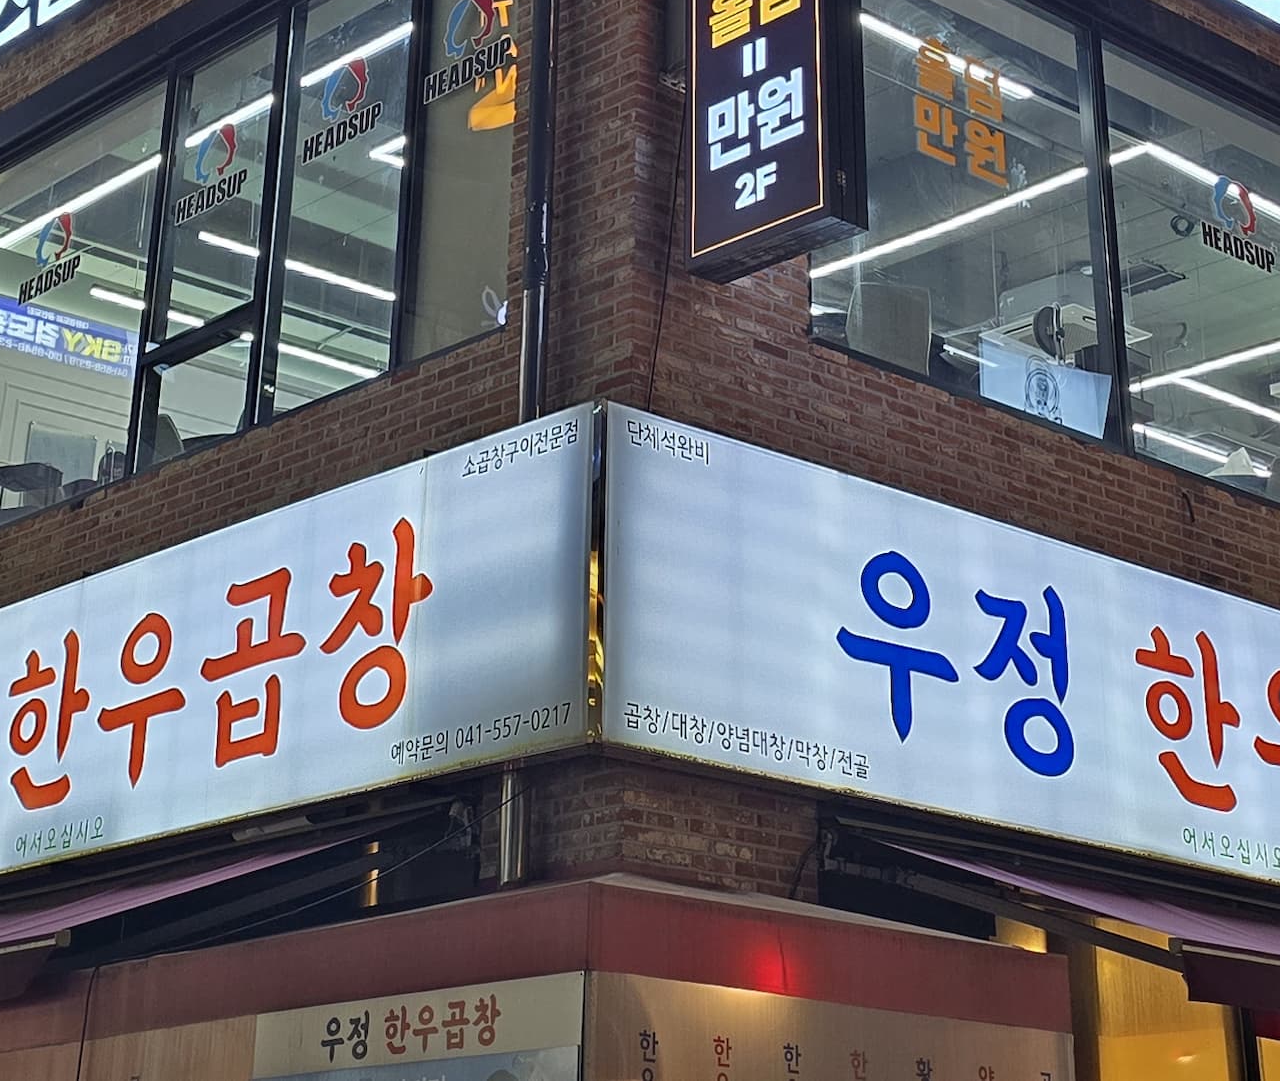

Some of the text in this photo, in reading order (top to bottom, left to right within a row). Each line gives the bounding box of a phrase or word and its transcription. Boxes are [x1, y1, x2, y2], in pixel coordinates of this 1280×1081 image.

[424, 36, 513, 105] HEADSUP
[301, 101, 383, 165] HEADSUP
[706, 65, 806, 173] 만원
[913, 90, 1010, 189] 만원
[174, 168, 249, 226] HEADSUP
[733, 161, 778, 212] 2F
[1201, 220, 1277, 274] HEADSUP
[17, 254, 81, 307] HEADSUP
[461, 417, 581, 480] 소곱창구이전문점
[624, 418, 713, 468] 단체석완비
[7, 515, 435, 813] 한우곱창
[835, 548, 1076, 779] 우정
[389, 700, 573, 767] 예약문의 041-557-0217
[622, 700, 873, 783] 곱창/대창/양념대창/막창/전골
[14, 815, 106, 857] 어서오십시오
[320, 993, 502, 1064] 우정 한우곱창
